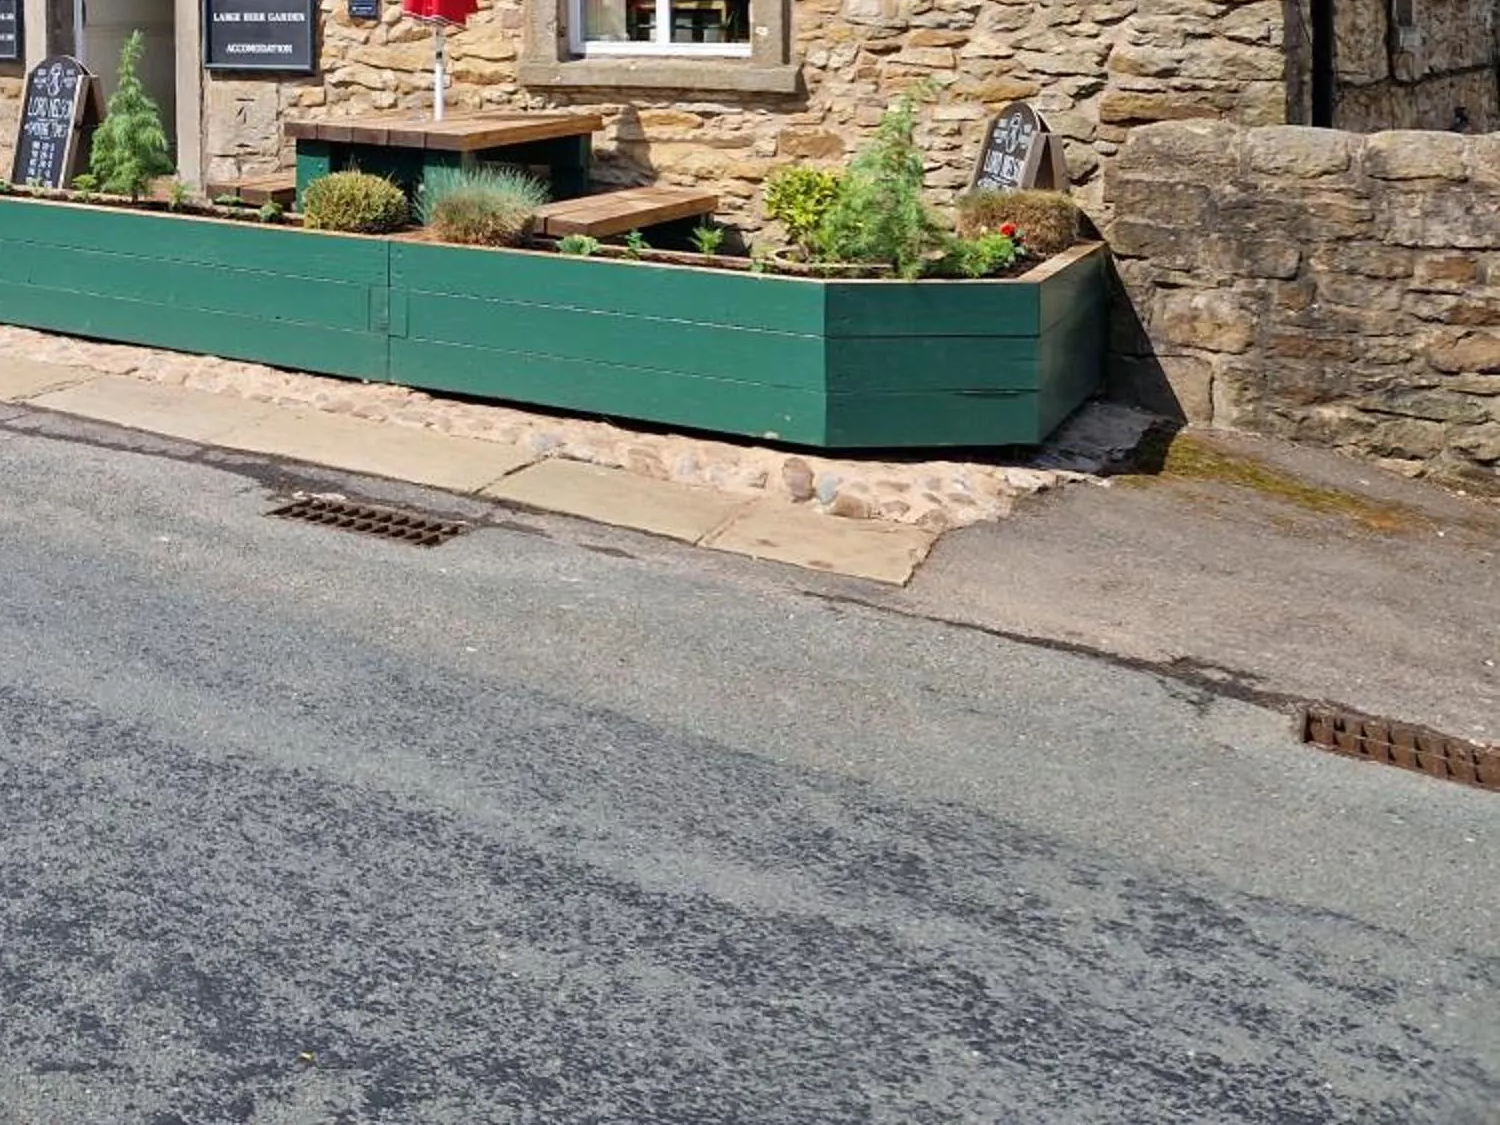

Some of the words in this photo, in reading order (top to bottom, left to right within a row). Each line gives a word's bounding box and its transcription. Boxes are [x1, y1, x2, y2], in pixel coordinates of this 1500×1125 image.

[213, 13, 241, 22] LARGE
[243, 12, 266, 22] BEER
[267, 12, 305, 22] GARDEN
